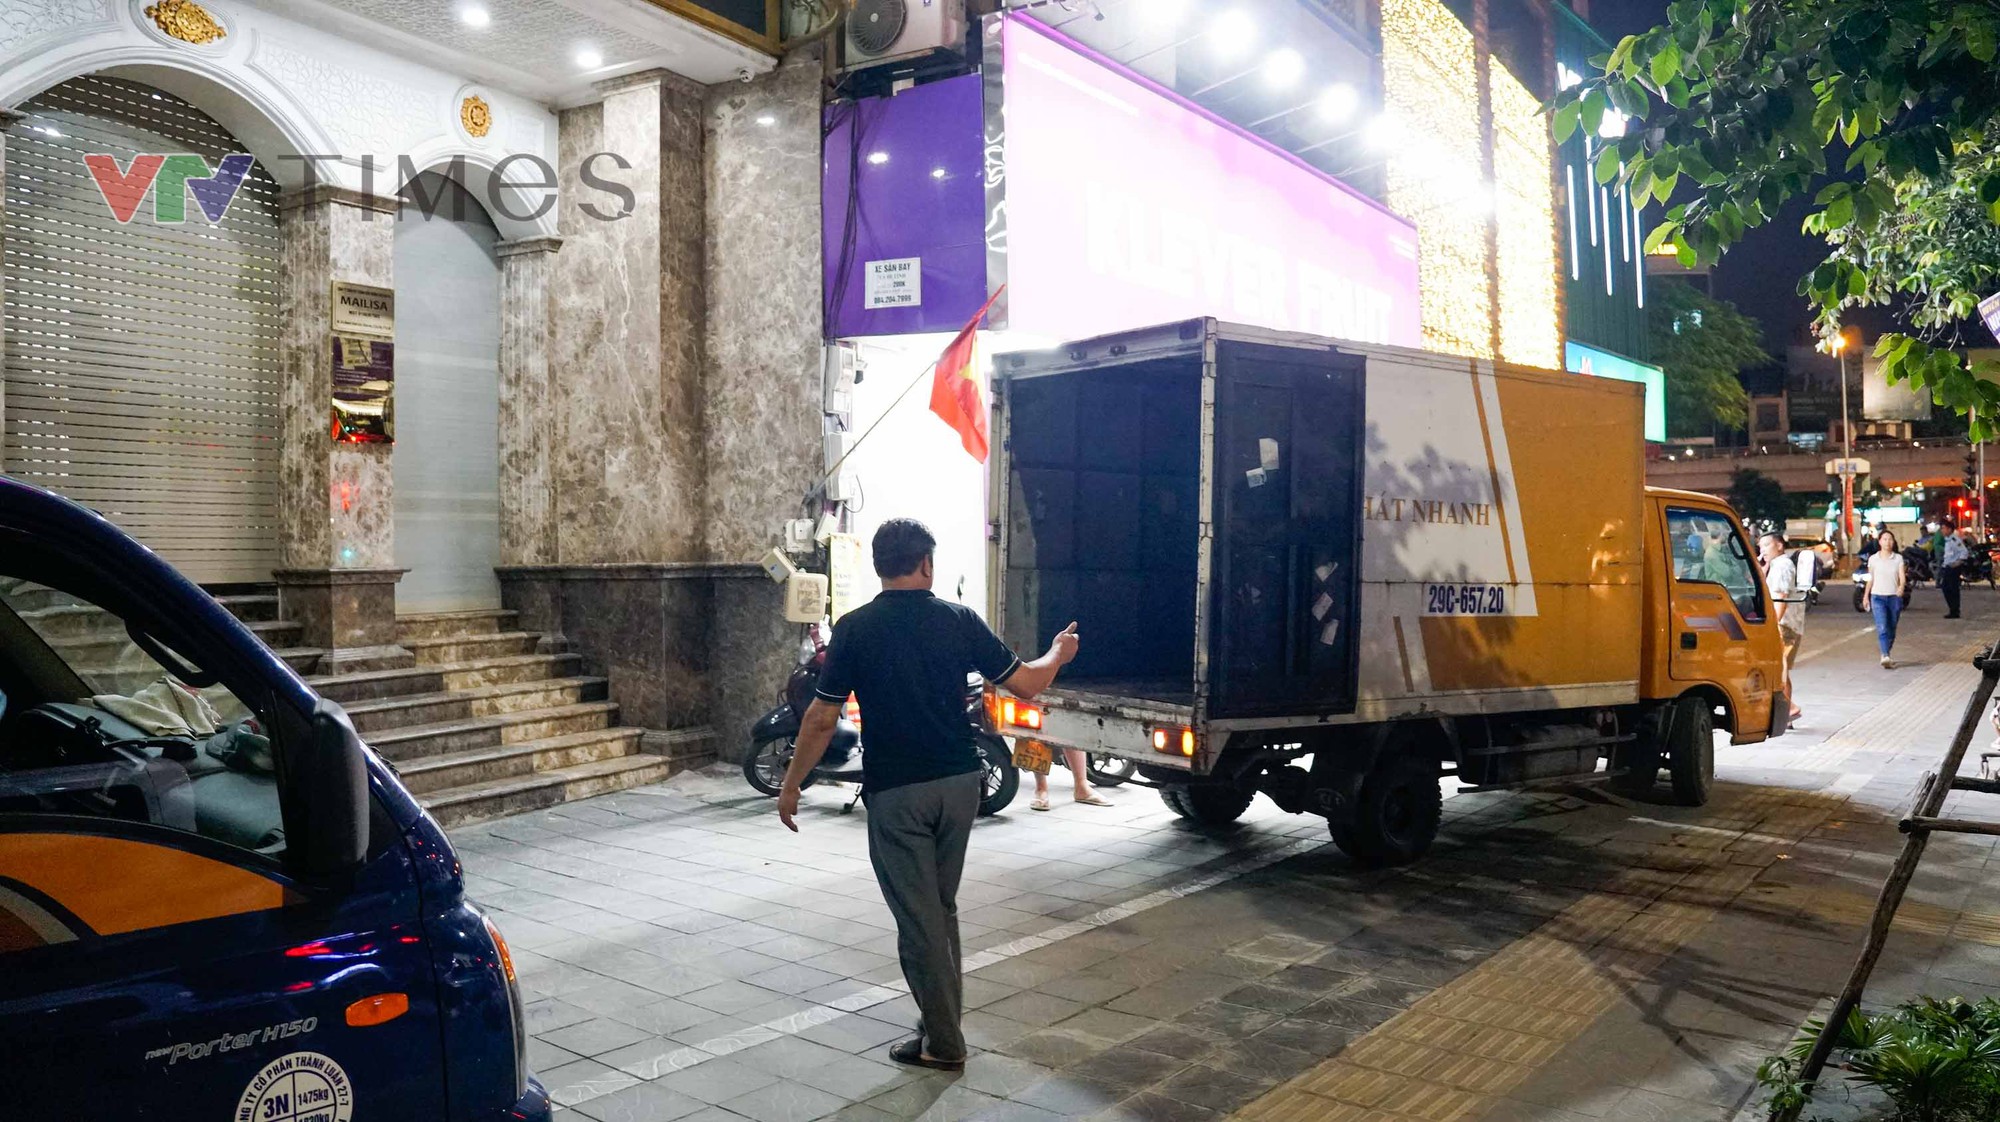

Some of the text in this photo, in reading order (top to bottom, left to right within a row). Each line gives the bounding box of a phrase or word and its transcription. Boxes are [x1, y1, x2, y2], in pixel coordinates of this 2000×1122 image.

[340, 295, 388, 312] MAILISA
[1364, 491, 1490, 526] HÁT NHANH
[1428, 585, 1505, 614] 29C-657.20
[169, 1032, 261, 1065] Porter
[261, 1016, 318, 1043] H150
[245, 1091, 257, 1104] TY
[263, 1093, 289, 1119] 3N
[298, 1088, 329, 1106] 1475kg
